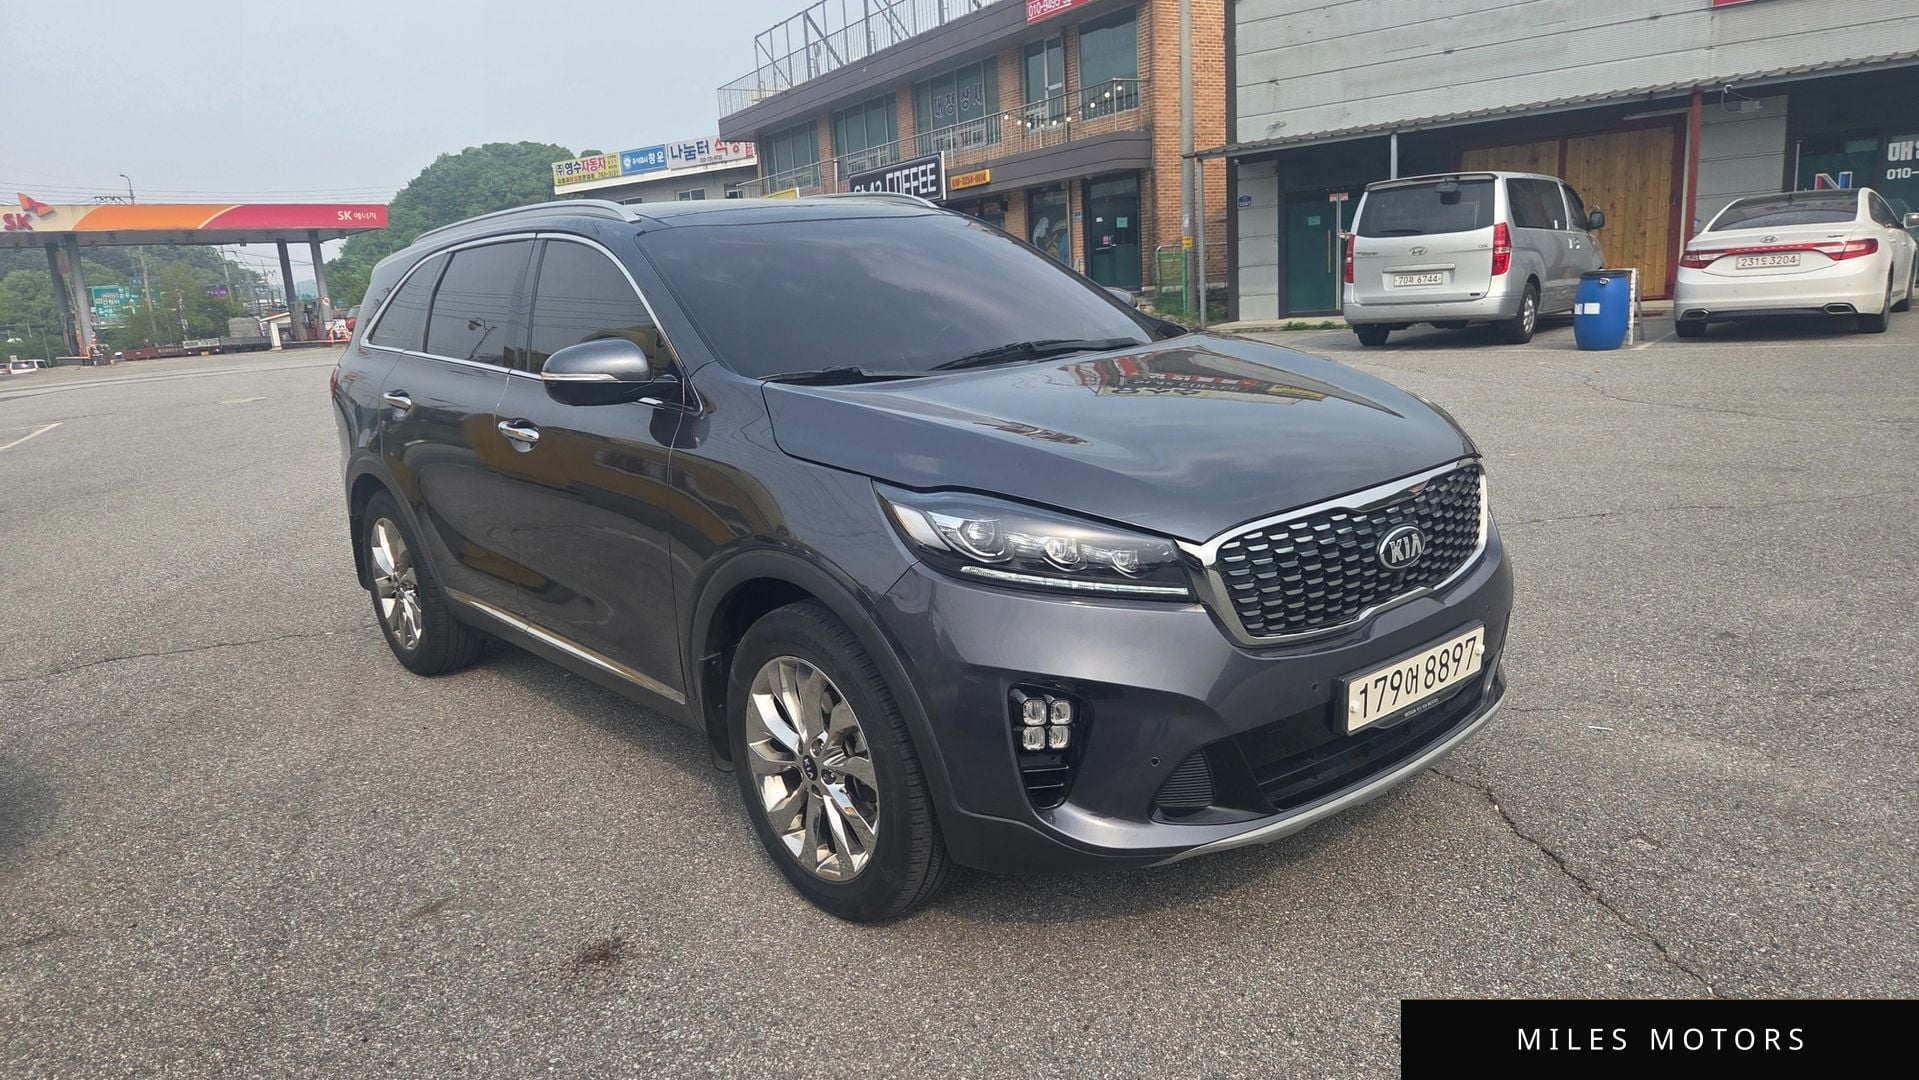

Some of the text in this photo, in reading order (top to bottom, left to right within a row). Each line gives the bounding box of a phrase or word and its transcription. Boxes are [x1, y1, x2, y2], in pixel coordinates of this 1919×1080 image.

[670, 140, 709, 160] 나눔터
[3, 213, 33, 230] SK
[337, 210, 376, 220] SK 에너지
[1769, 255, 1796, 265] 3204
[1417, 275, 1438, 284] 6744
[1389, 533, 1422, 563] KIA
[1359, 636, 1477, 719] 179어 8897
[804, 757, 814, 779] KIA
